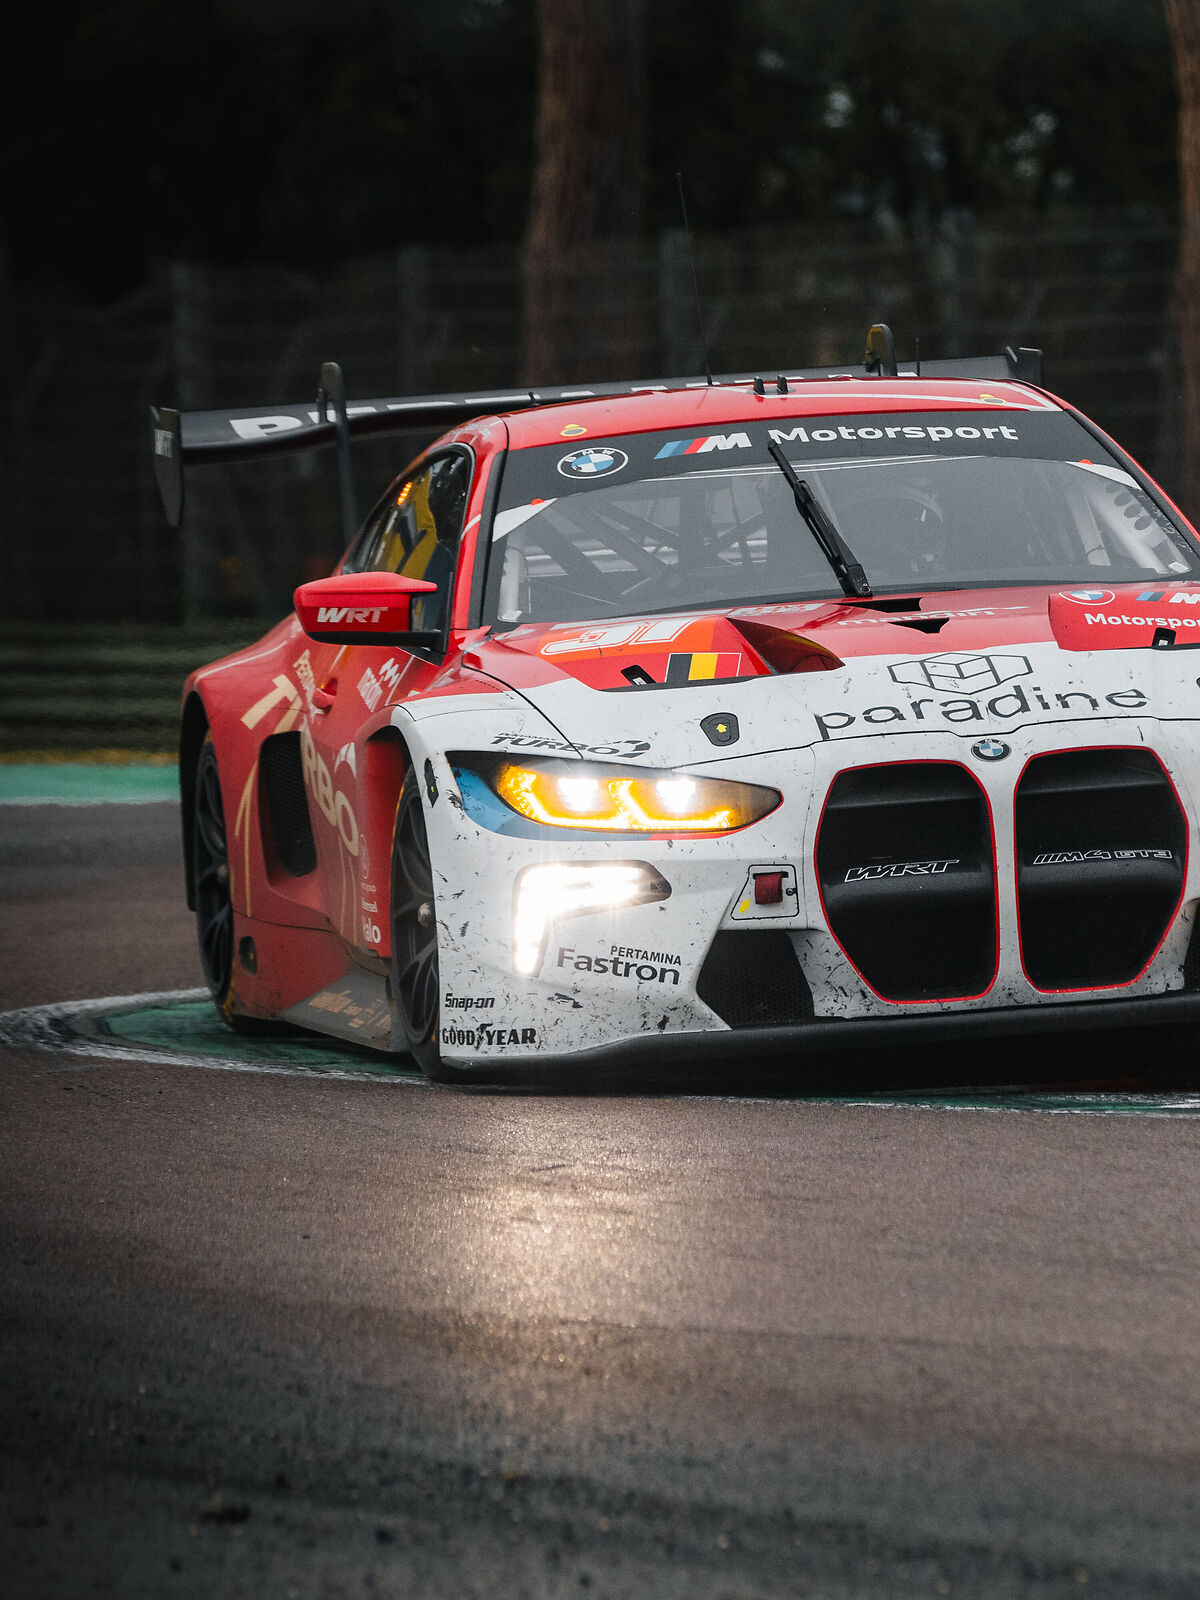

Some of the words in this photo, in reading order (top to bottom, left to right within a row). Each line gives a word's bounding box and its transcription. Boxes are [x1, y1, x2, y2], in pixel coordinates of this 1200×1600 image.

[767, 425, 1019, 442] Motorsport
[317, 607, 387, 623] WRT
[814, 684, 1150, 741] paradine
[490, 736, 620, 755] TURBO
[1114, 849, 1172, 859] GT3
[844, 860, 960, 882] WRT
[610, 945, 682, 966] PERTAMINA
[557, 947, 681, 986] Fastron
[445, 993, 495, 1012] Snap-on
